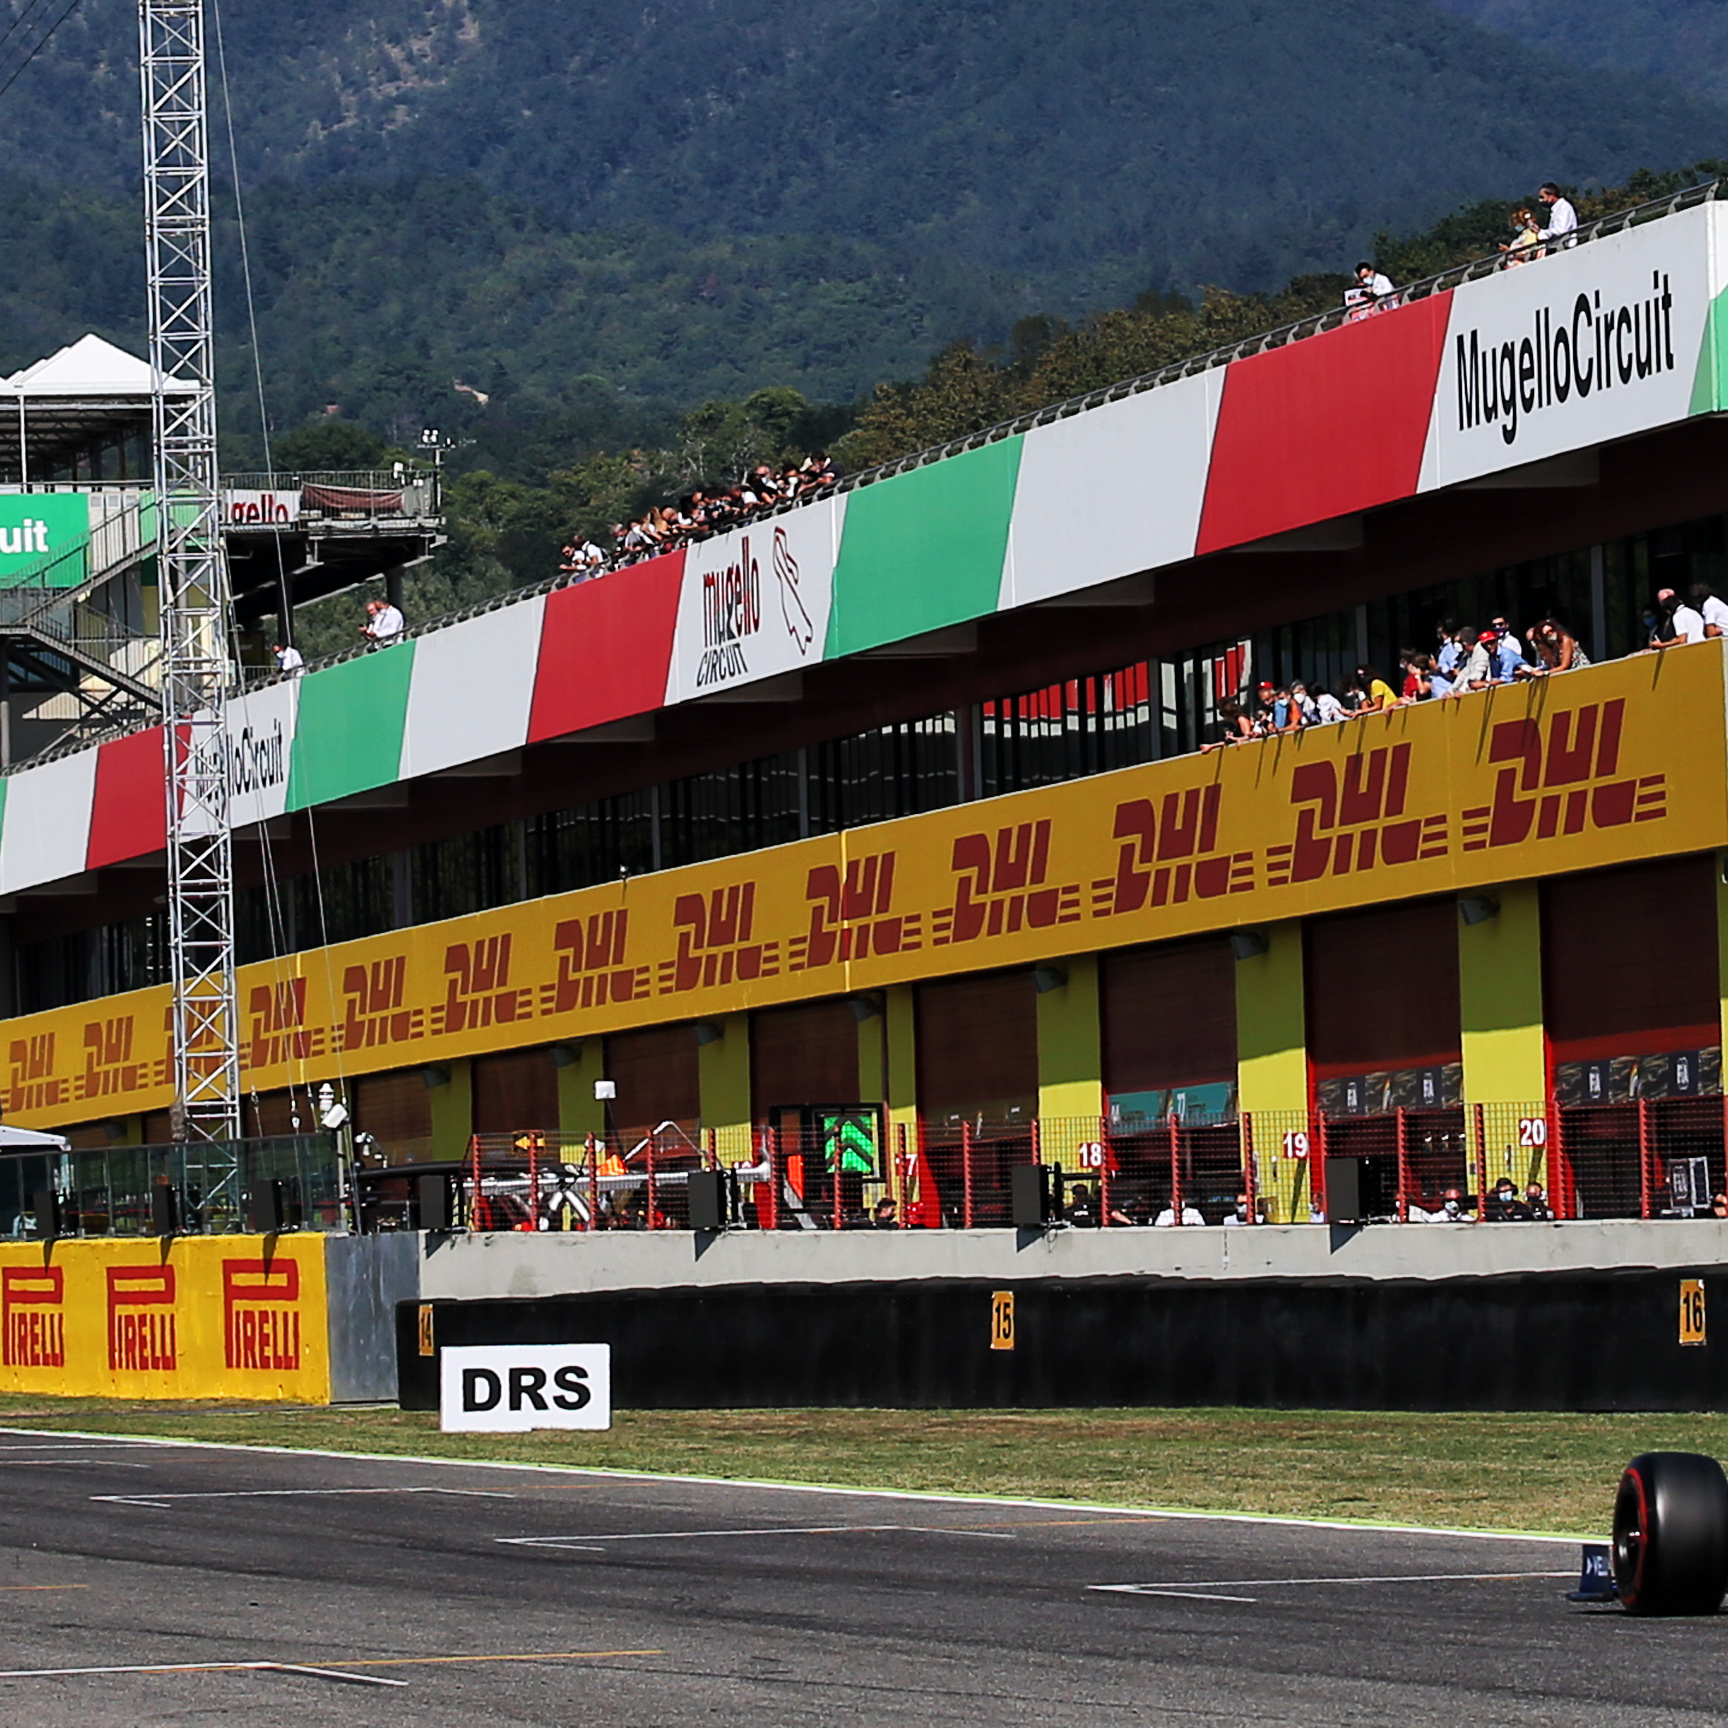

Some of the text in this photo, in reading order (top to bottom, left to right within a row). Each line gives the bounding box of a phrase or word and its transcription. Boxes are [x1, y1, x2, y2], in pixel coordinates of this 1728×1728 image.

[1456, 271, 1674, 444] MugelloCircuit
[697, 642, 749, 687] CIRCUIT
[195, 718, 284, 816] MuglloCircuit
[1290, 742, 1422, 884] DHL
[1488, 697, 1637, 848] DHL
[952, 818, 1059, 943] DHL
[1113, 783, 1231, 916] DHL
[673, 881, 763, 992] DHL
[806, 851, 903, 969] DHL
[343, 955, 412, 1052] DHL
[443, 933, 518, 1034] DHL
[554, 908, 636, 1014] DHL
[84, 1015, 140, 1101] DHL
[249, 977, 312, 1069] DHL
[9, 1032, 60, 1113] DHL
[896, 1154, 918, 1175] 7
[1079, 1142, 1103, 1167] 18
[1284, 1129, 1309, 1158] 19
[1520, 1118, 1546, 1146] 20
[2, 1265, 64, 1368] PIRELLI
[107, 1264, 177, 1371] PIRELLI
[222, 1258, 300, 1370] PIRELLI
[420, 1311, 432, 1347] 14
[994, 1301, 1012, 1340] 15
[1683, 1291, 1703, 1333] 16
[462, 1366, 592, 1413] DRS
